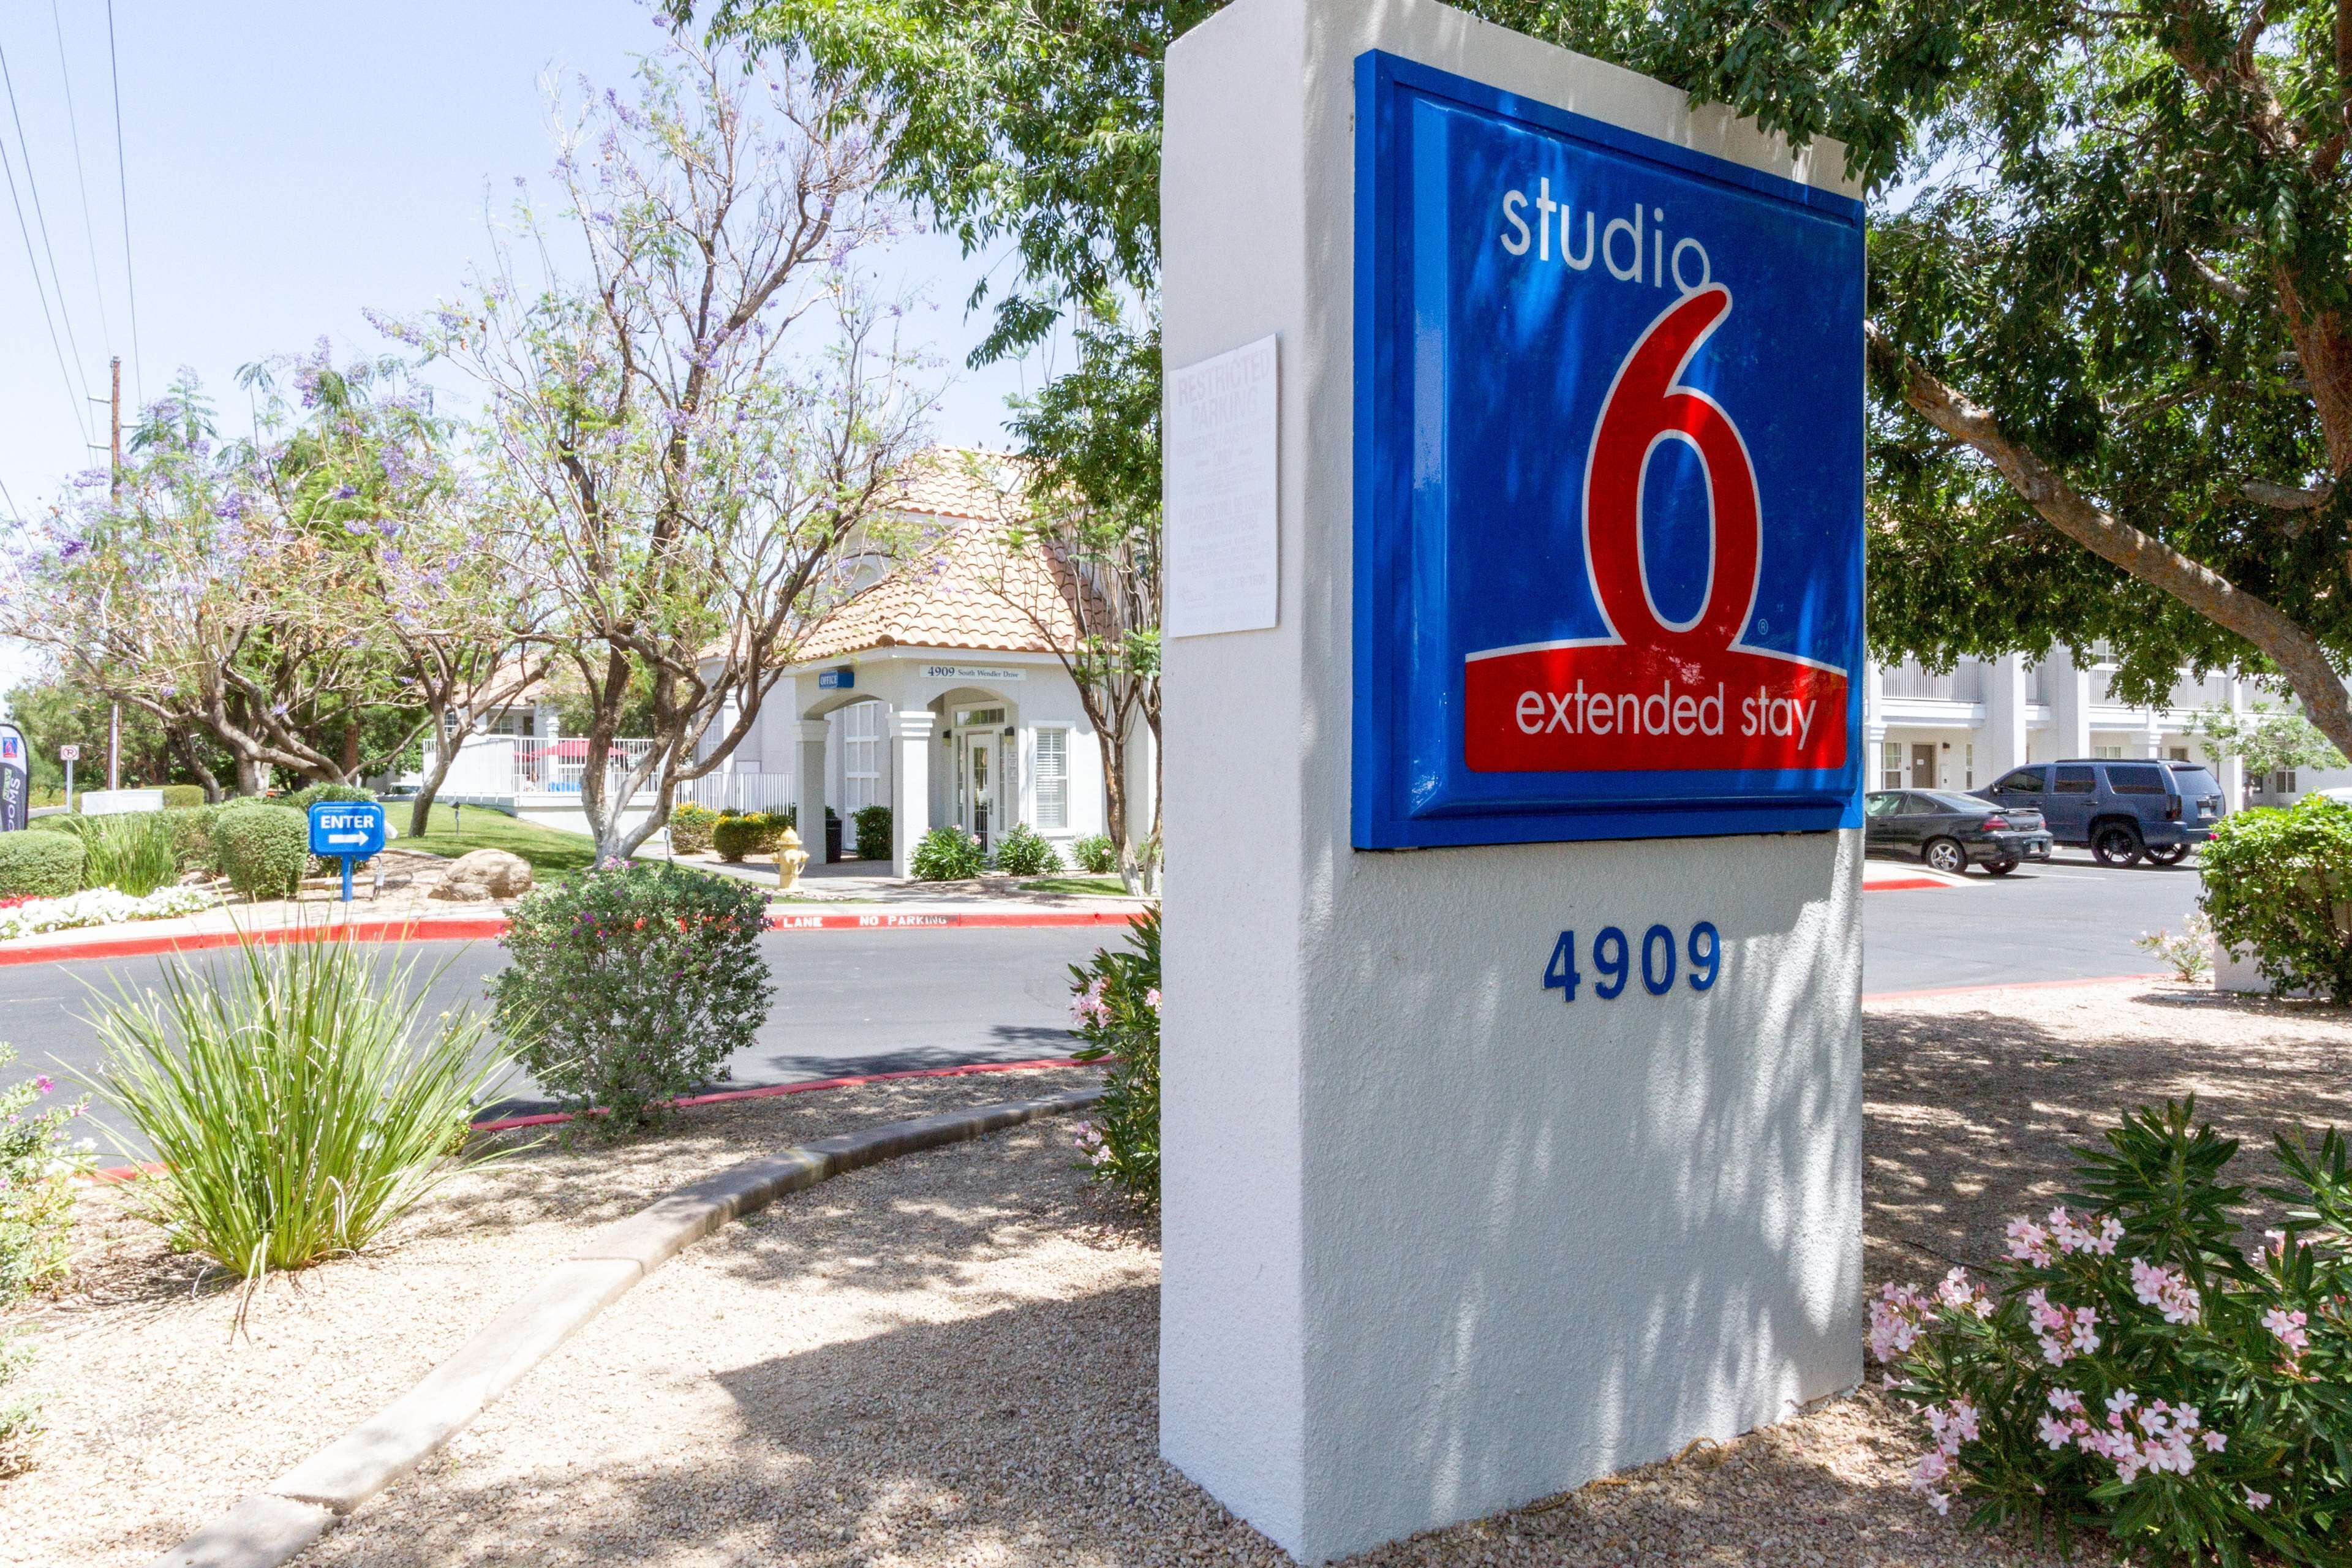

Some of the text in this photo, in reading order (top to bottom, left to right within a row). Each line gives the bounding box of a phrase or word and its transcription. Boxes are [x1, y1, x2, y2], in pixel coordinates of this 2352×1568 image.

[1501, 178, 1713, 294] studio
[1178, 348, 1270, 405] RESTRICTED
[1191, 386, 1257, 431] PARKING
[1581, 282, 1763, 646] 6
[820, 675, 837, 685] OFFICE
[928, 666, 955, 677] 4909
[1517, 680, 1815, 750] extended stay
[8, 777, 21, 833] OOMS
[321, 815, 374, 829] ENTER
[783, 918, 823, 927] LANE
[859, 916, 947, 925] NO PARKING
[1541, 921, 1721, 1002] 4909
